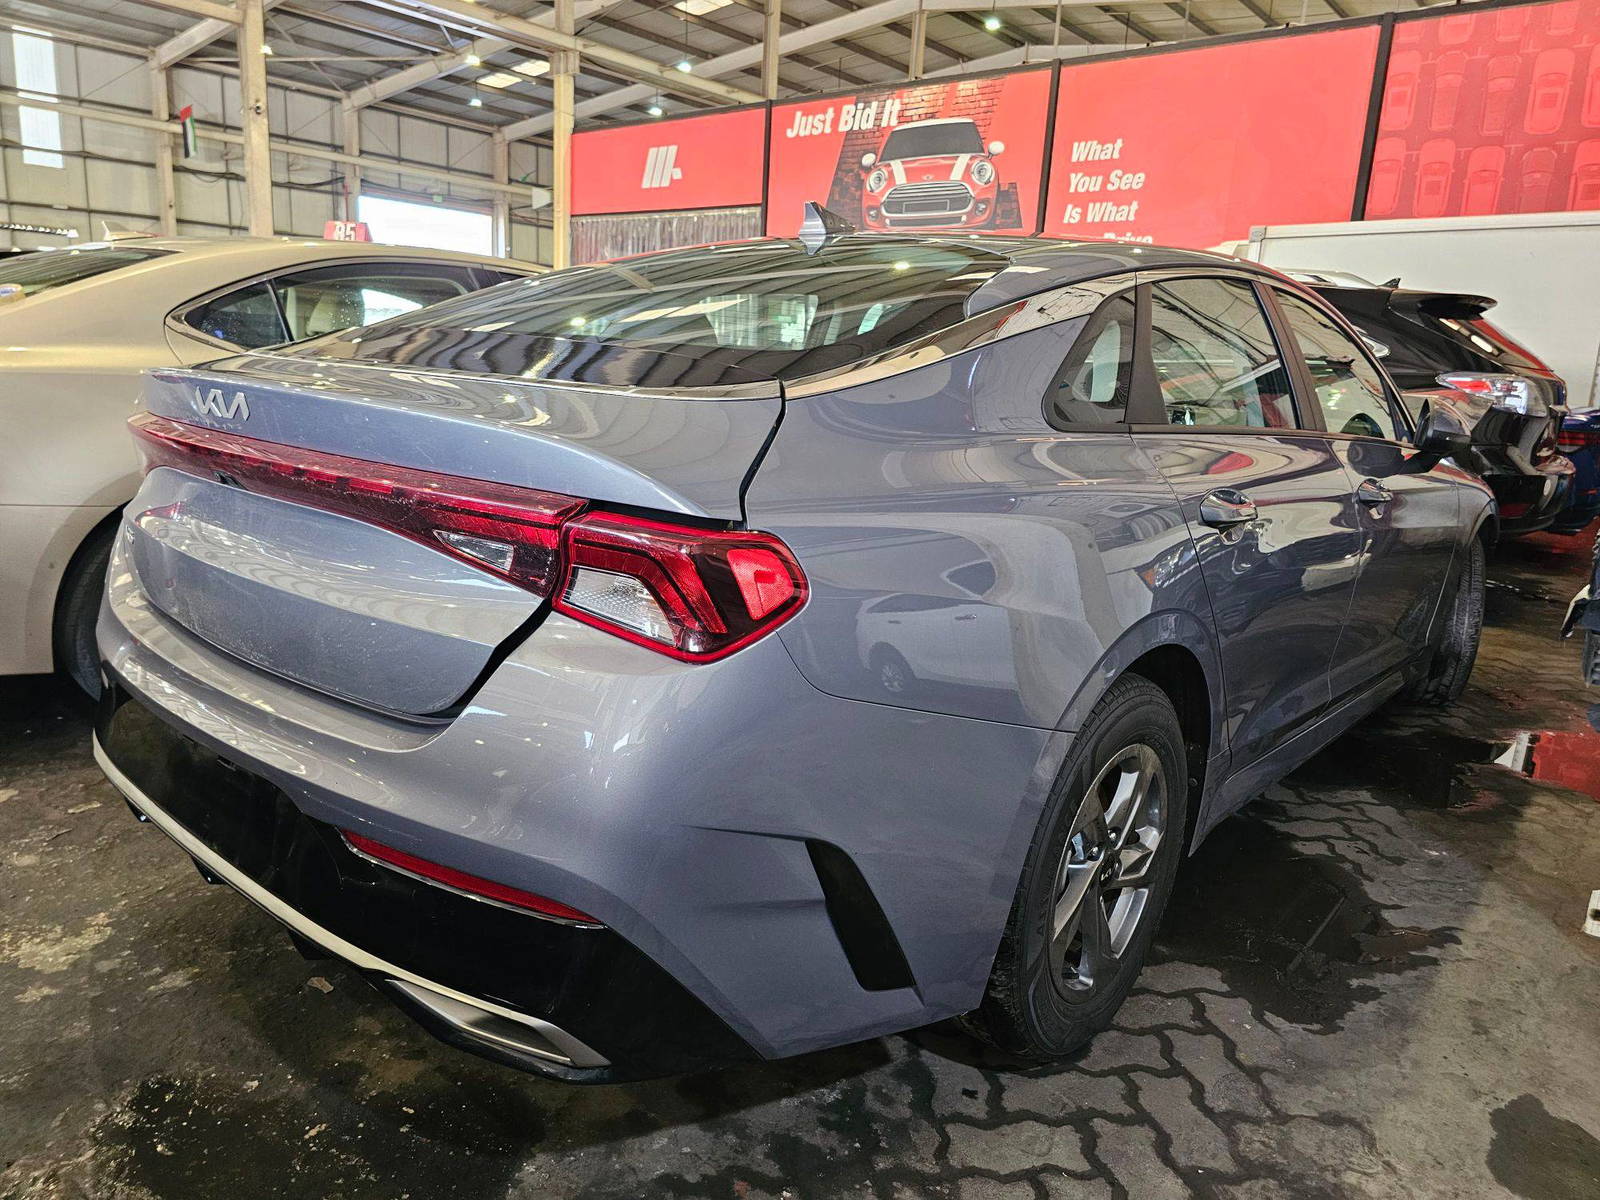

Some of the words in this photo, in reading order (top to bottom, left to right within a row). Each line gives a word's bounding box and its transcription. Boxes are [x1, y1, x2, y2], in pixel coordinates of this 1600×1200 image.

[786, 107, 835, 138] Just
[838, 101, 878, 132] Bid
[881, 98, 901, 128] It
[1071, 138, 1123, 163] What
[1069, 172, 1104, 193] You
[1106, 169, 1146, 191] See
[1063, 203, 1082, 224] Is
[1087, 200, 1139, 223] What
[195, 386, 251, 421] KIA
